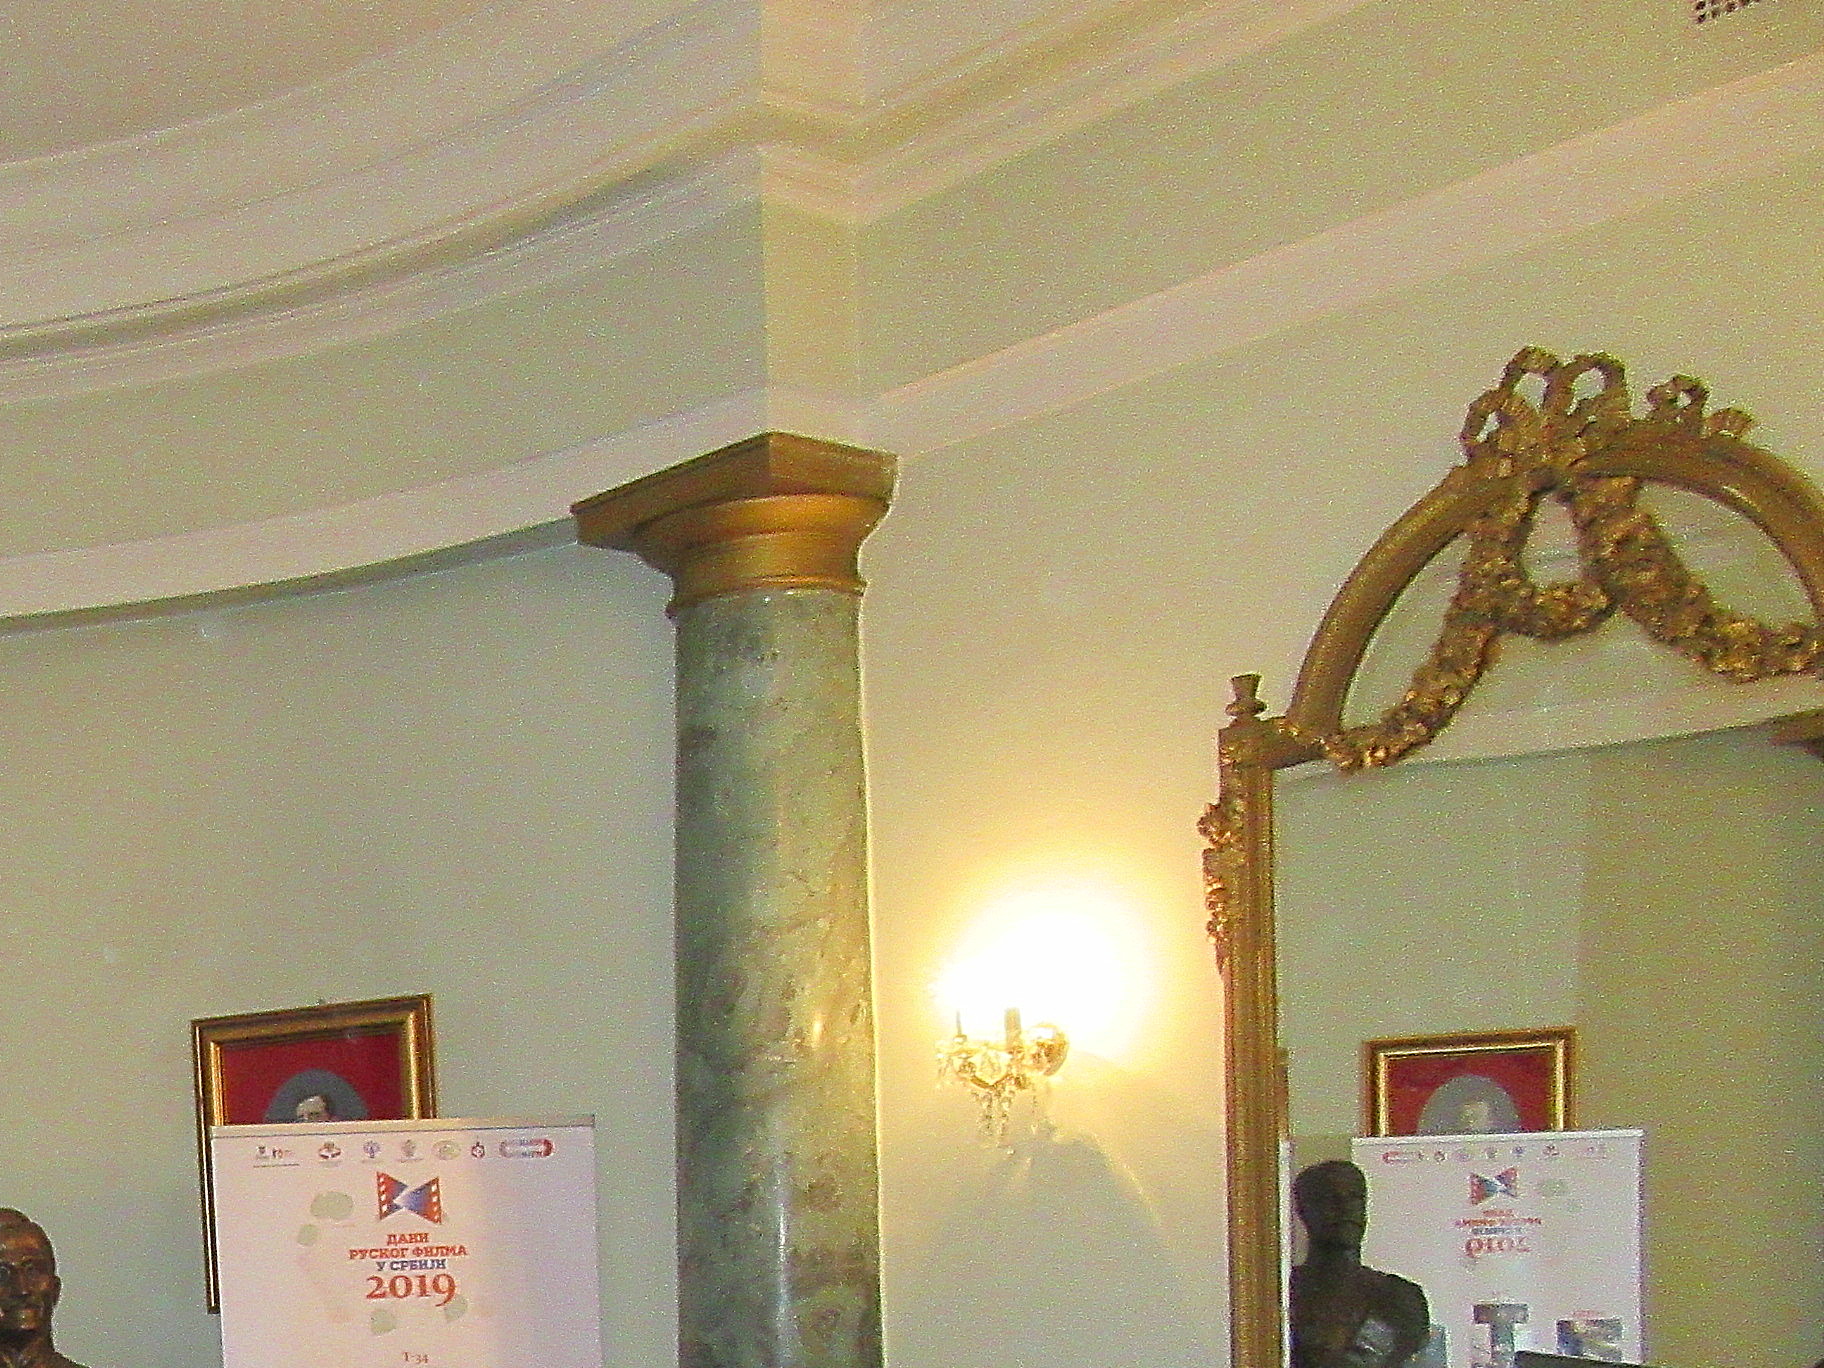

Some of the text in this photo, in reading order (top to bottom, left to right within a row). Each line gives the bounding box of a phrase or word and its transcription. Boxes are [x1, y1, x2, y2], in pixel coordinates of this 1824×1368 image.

[386, 1232, 429, 1246] ДАНИ
[349, 1244, 468, 1260] РУСКОГ ФИЛМА
[376, 1258, 447, 1272] У СРБИЈИ
[366, 1273, 456, 1307] 2019
